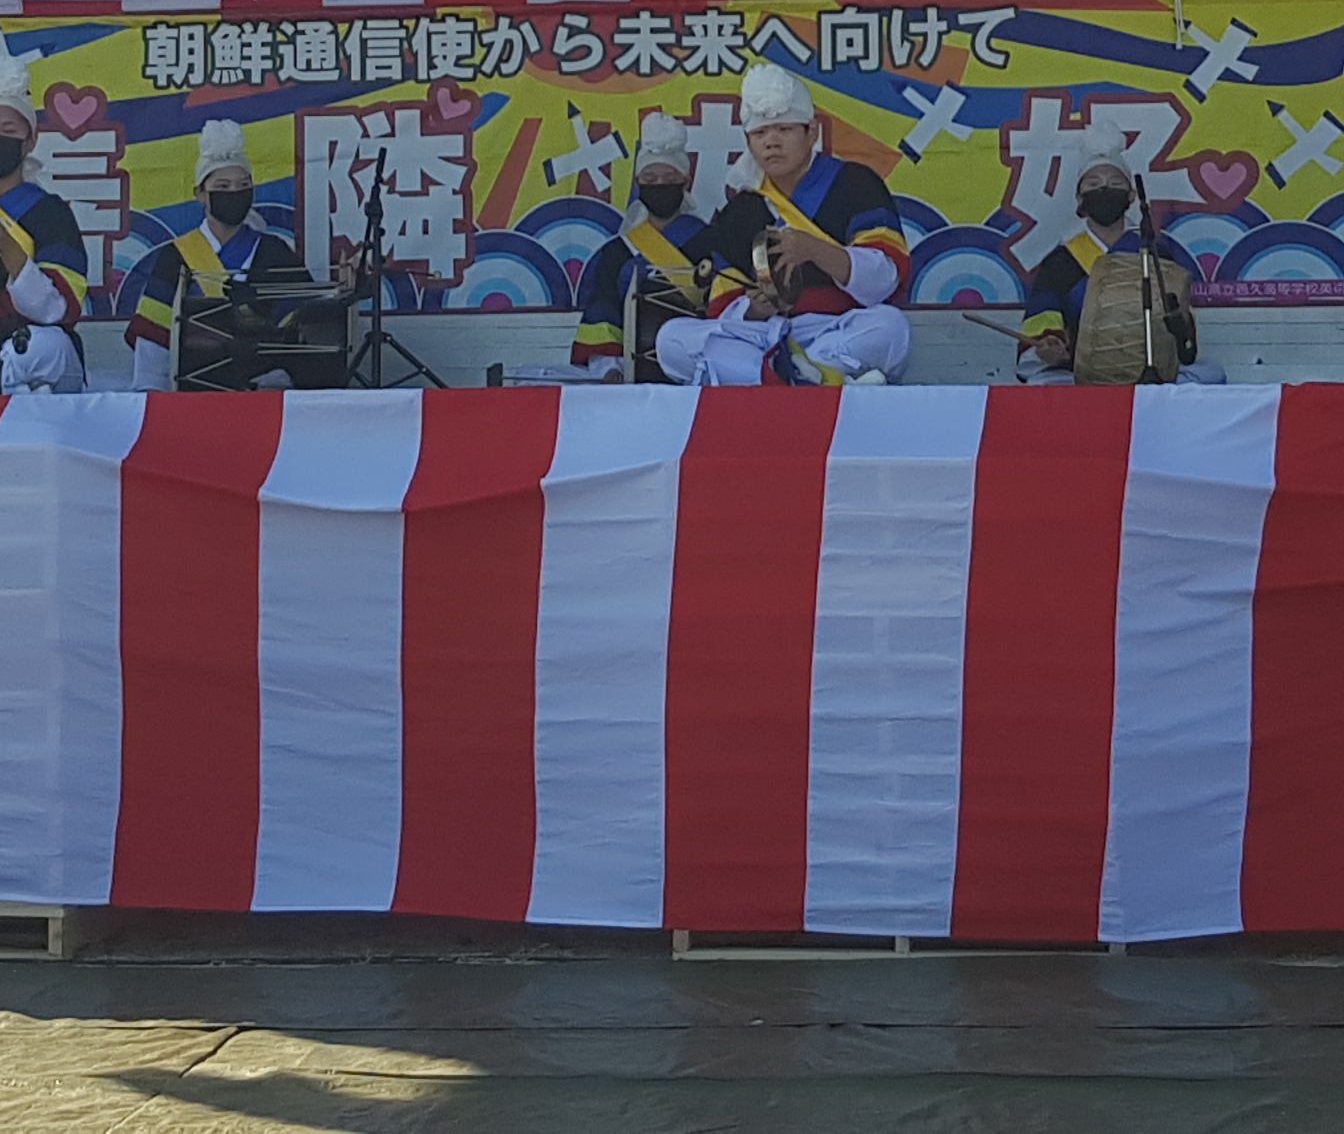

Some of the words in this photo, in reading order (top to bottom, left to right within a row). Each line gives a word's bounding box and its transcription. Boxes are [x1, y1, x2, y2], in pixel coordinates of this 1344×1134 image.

[143, 4, 1018, 88] 朝鮮通信使から未来へ向けて
